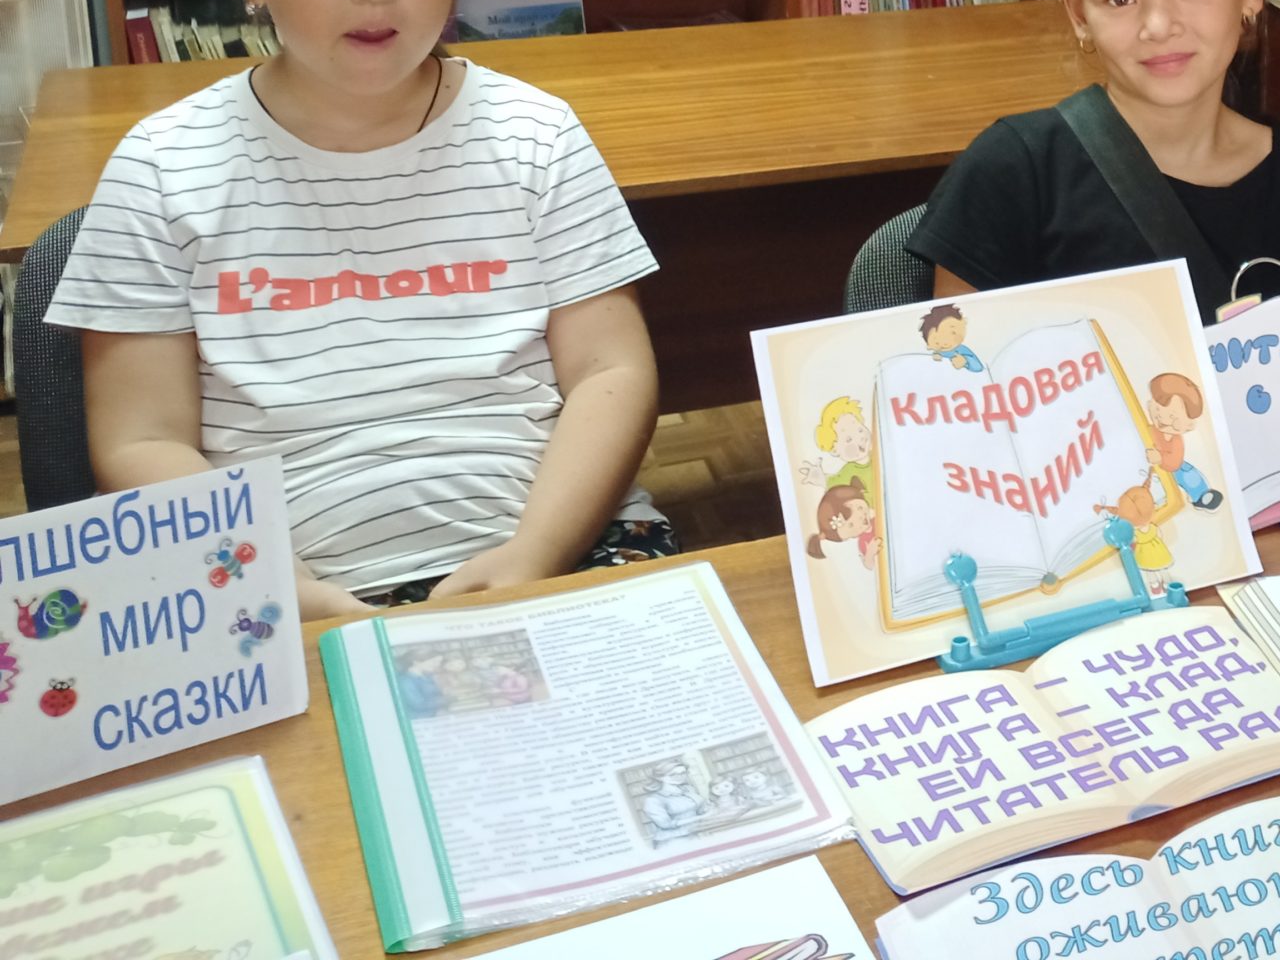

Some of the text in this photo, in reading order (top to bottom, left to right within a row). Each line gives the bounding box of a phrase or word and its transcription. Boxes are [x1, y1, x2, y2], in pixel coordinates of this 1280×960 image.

[217, 259, 508, 315] L'amour
[942, 409, 1105, 518] знаний
[99, 586, 208, 657] мир
[92, 662, 269, 751] сказки
[818, 624, 1240, 759] КНИГА ЧУДО,
[836, 651, 1268, 790] КНИГА КЛАД,
[918, 687, 1245, 802] ЕЙ ВСЕГДА
[870, 743, 1190, 849] ЧИТАТЕЛЬ
[970, 859, 1144, 926] Здесь
